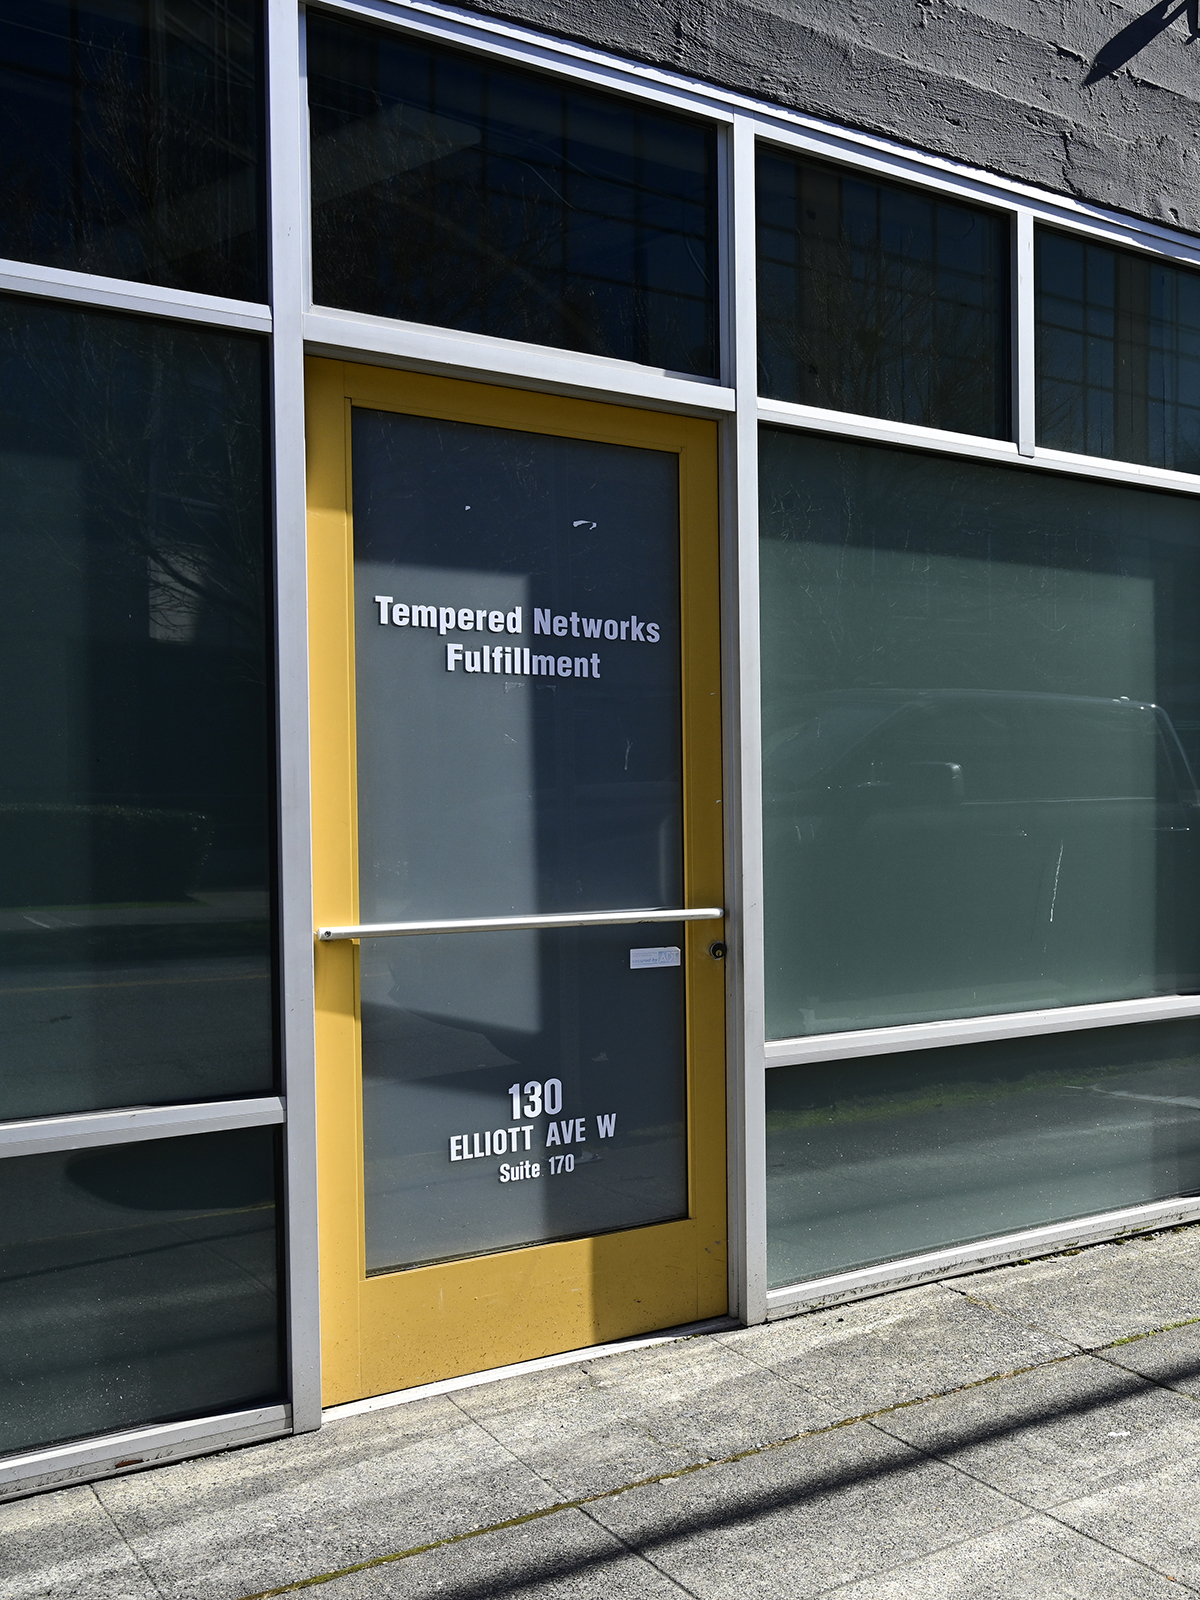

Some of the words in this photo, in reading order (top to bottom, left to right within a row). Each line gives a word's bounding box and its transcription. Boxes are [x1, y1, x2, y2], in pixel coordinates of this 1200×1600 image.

[375, 595, 523, 635] Tempered
[533, 607, 661, 643] Networks
[446, 643, 601, 678] Fulfillment
[658, 951, 679, 964] ADT
[508, 1077, 563, 1120] 130
[450, 1124, 534, 1161] ELLIOTT
[546, 1117, 586, 1147] AVE
[596, 1112, 617, 1139] W
[500, 1160, 541, 1183] Suite
[548, 1153, 575, 1175] 170
